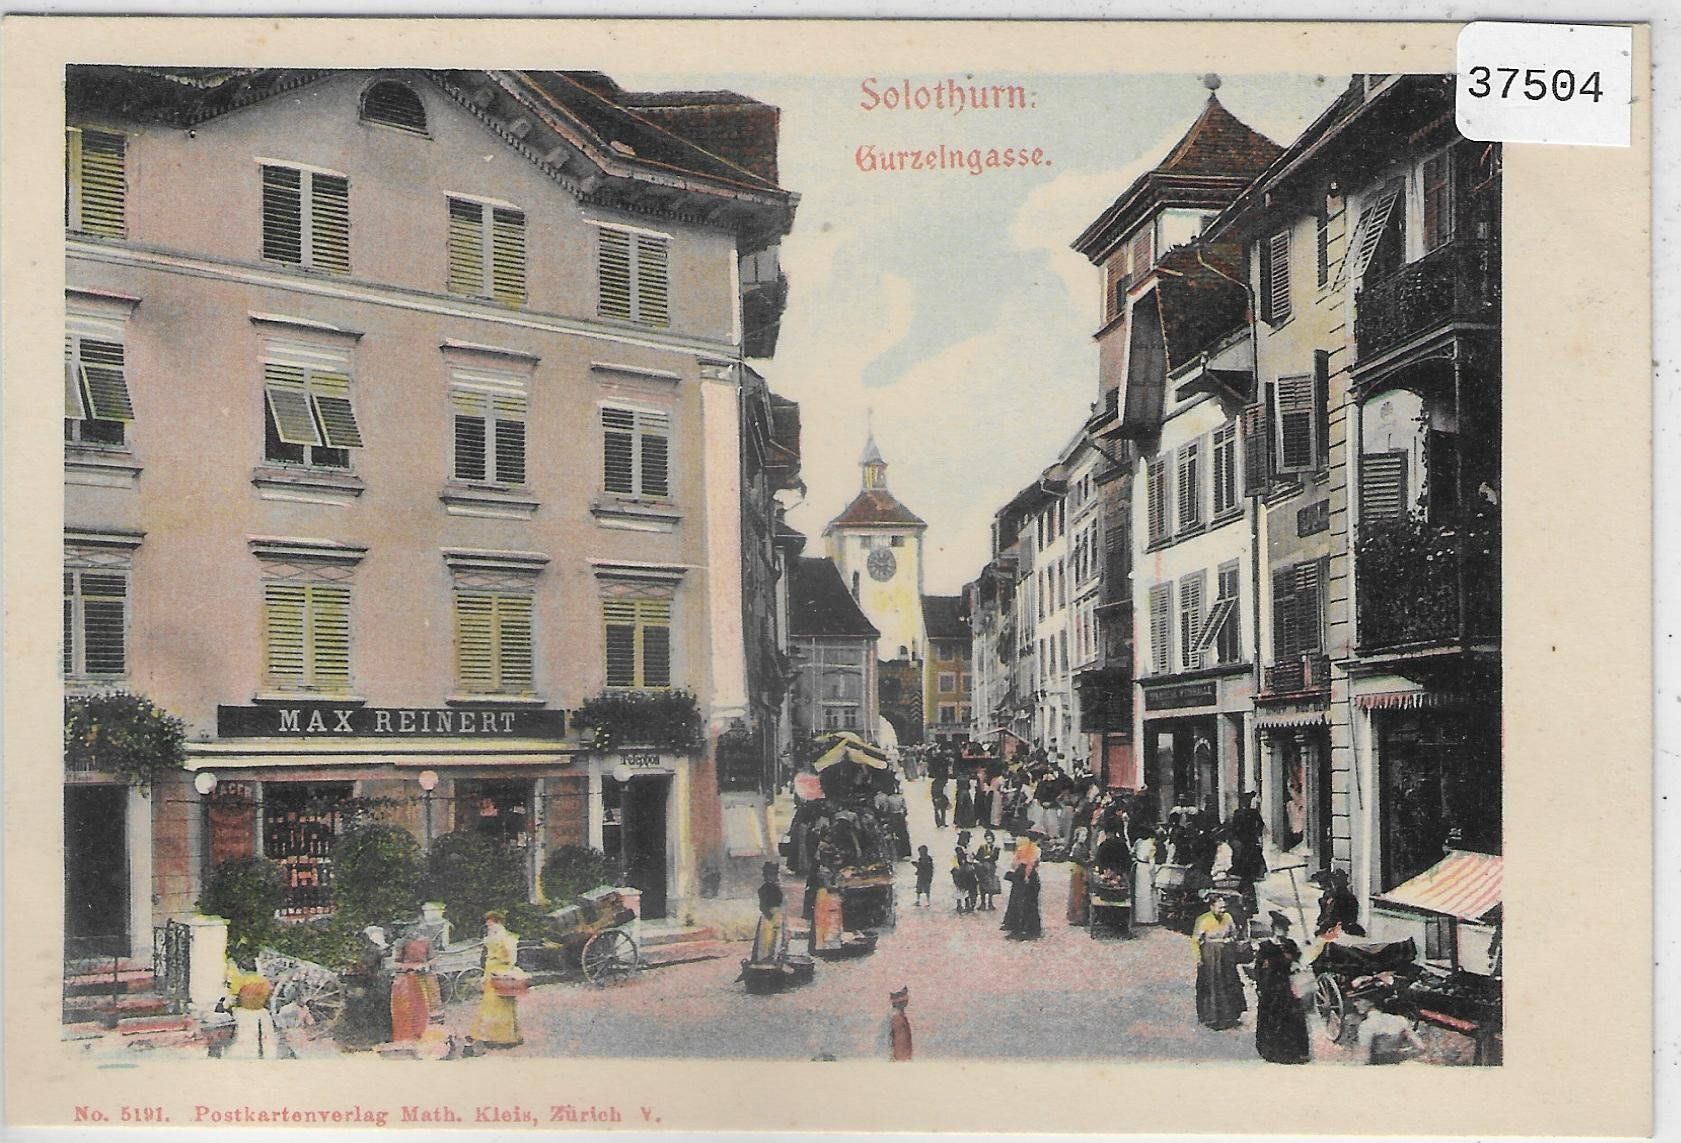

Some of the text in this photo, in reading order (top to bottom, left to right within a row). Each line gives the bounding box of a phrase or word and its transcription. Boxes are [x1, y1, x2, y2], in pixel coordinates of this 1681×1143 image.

[1468, 66, 1604, 103] 37504
[278, 708, 516, 734] MAX REINERT
